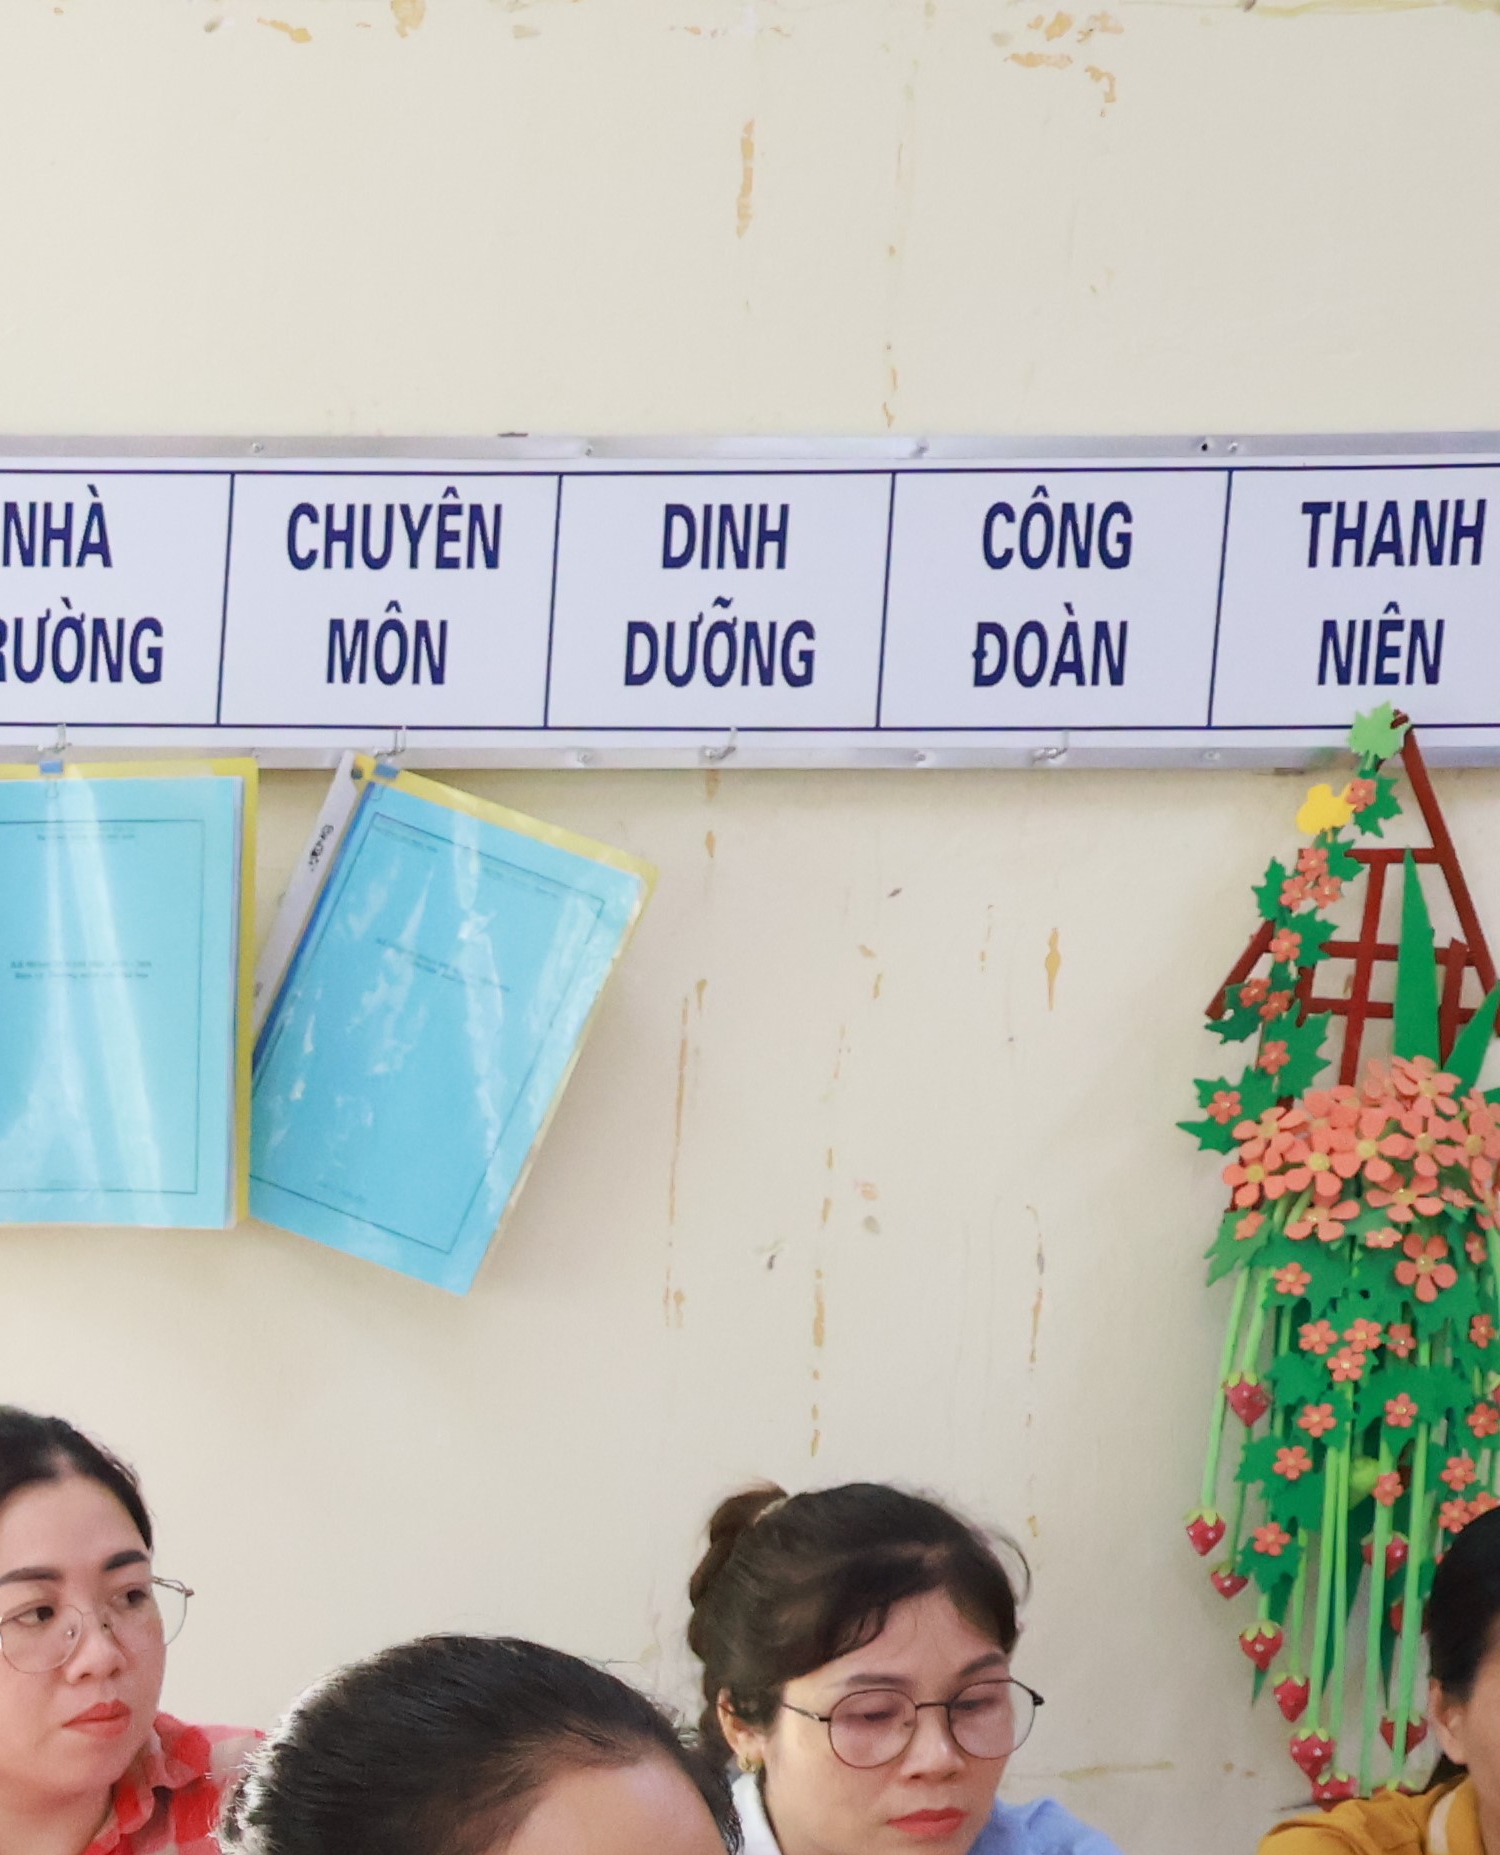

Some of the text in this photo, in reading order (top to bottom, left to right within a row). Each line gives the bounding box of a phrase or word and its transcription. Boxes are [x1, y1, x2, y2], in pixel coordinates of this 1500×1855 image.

[1, 483, 113, 569] NHÀ
[286, 485, 503, 571] CHUYÊN
[661, 502, 790, 570] DINH
[982, 484, 1134, 571] CÔNG
[1300, 498, 1487, 569] THANH
[326, 599, 448, 687] MÔN
[623, 595, 816, 689] DƯỠNG
[971, 601, 1128, 689] ĐOÀN
[1317, 600, 1445, 686] NIÊN
